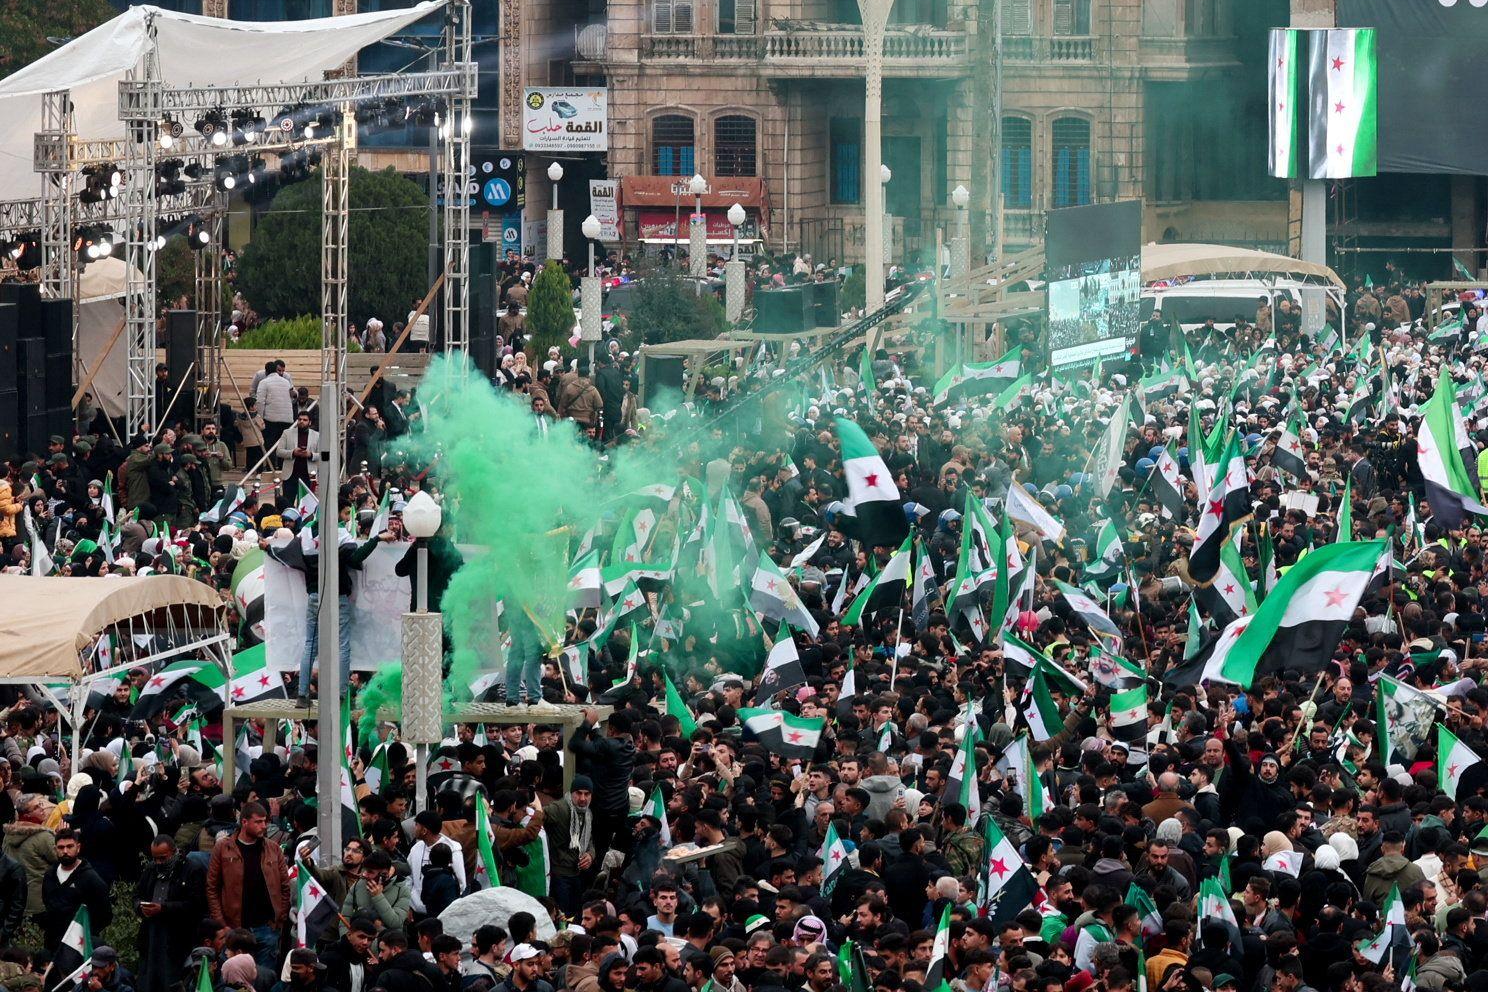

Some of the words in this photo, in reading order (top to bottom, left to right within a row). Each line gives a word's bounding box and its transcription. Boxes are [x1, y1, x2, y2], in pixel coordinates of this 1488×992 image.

[527, 117, 562, 135] حلب
[565, 121, 602, 133] القمة
[592, 186, 614, 198] القمة
